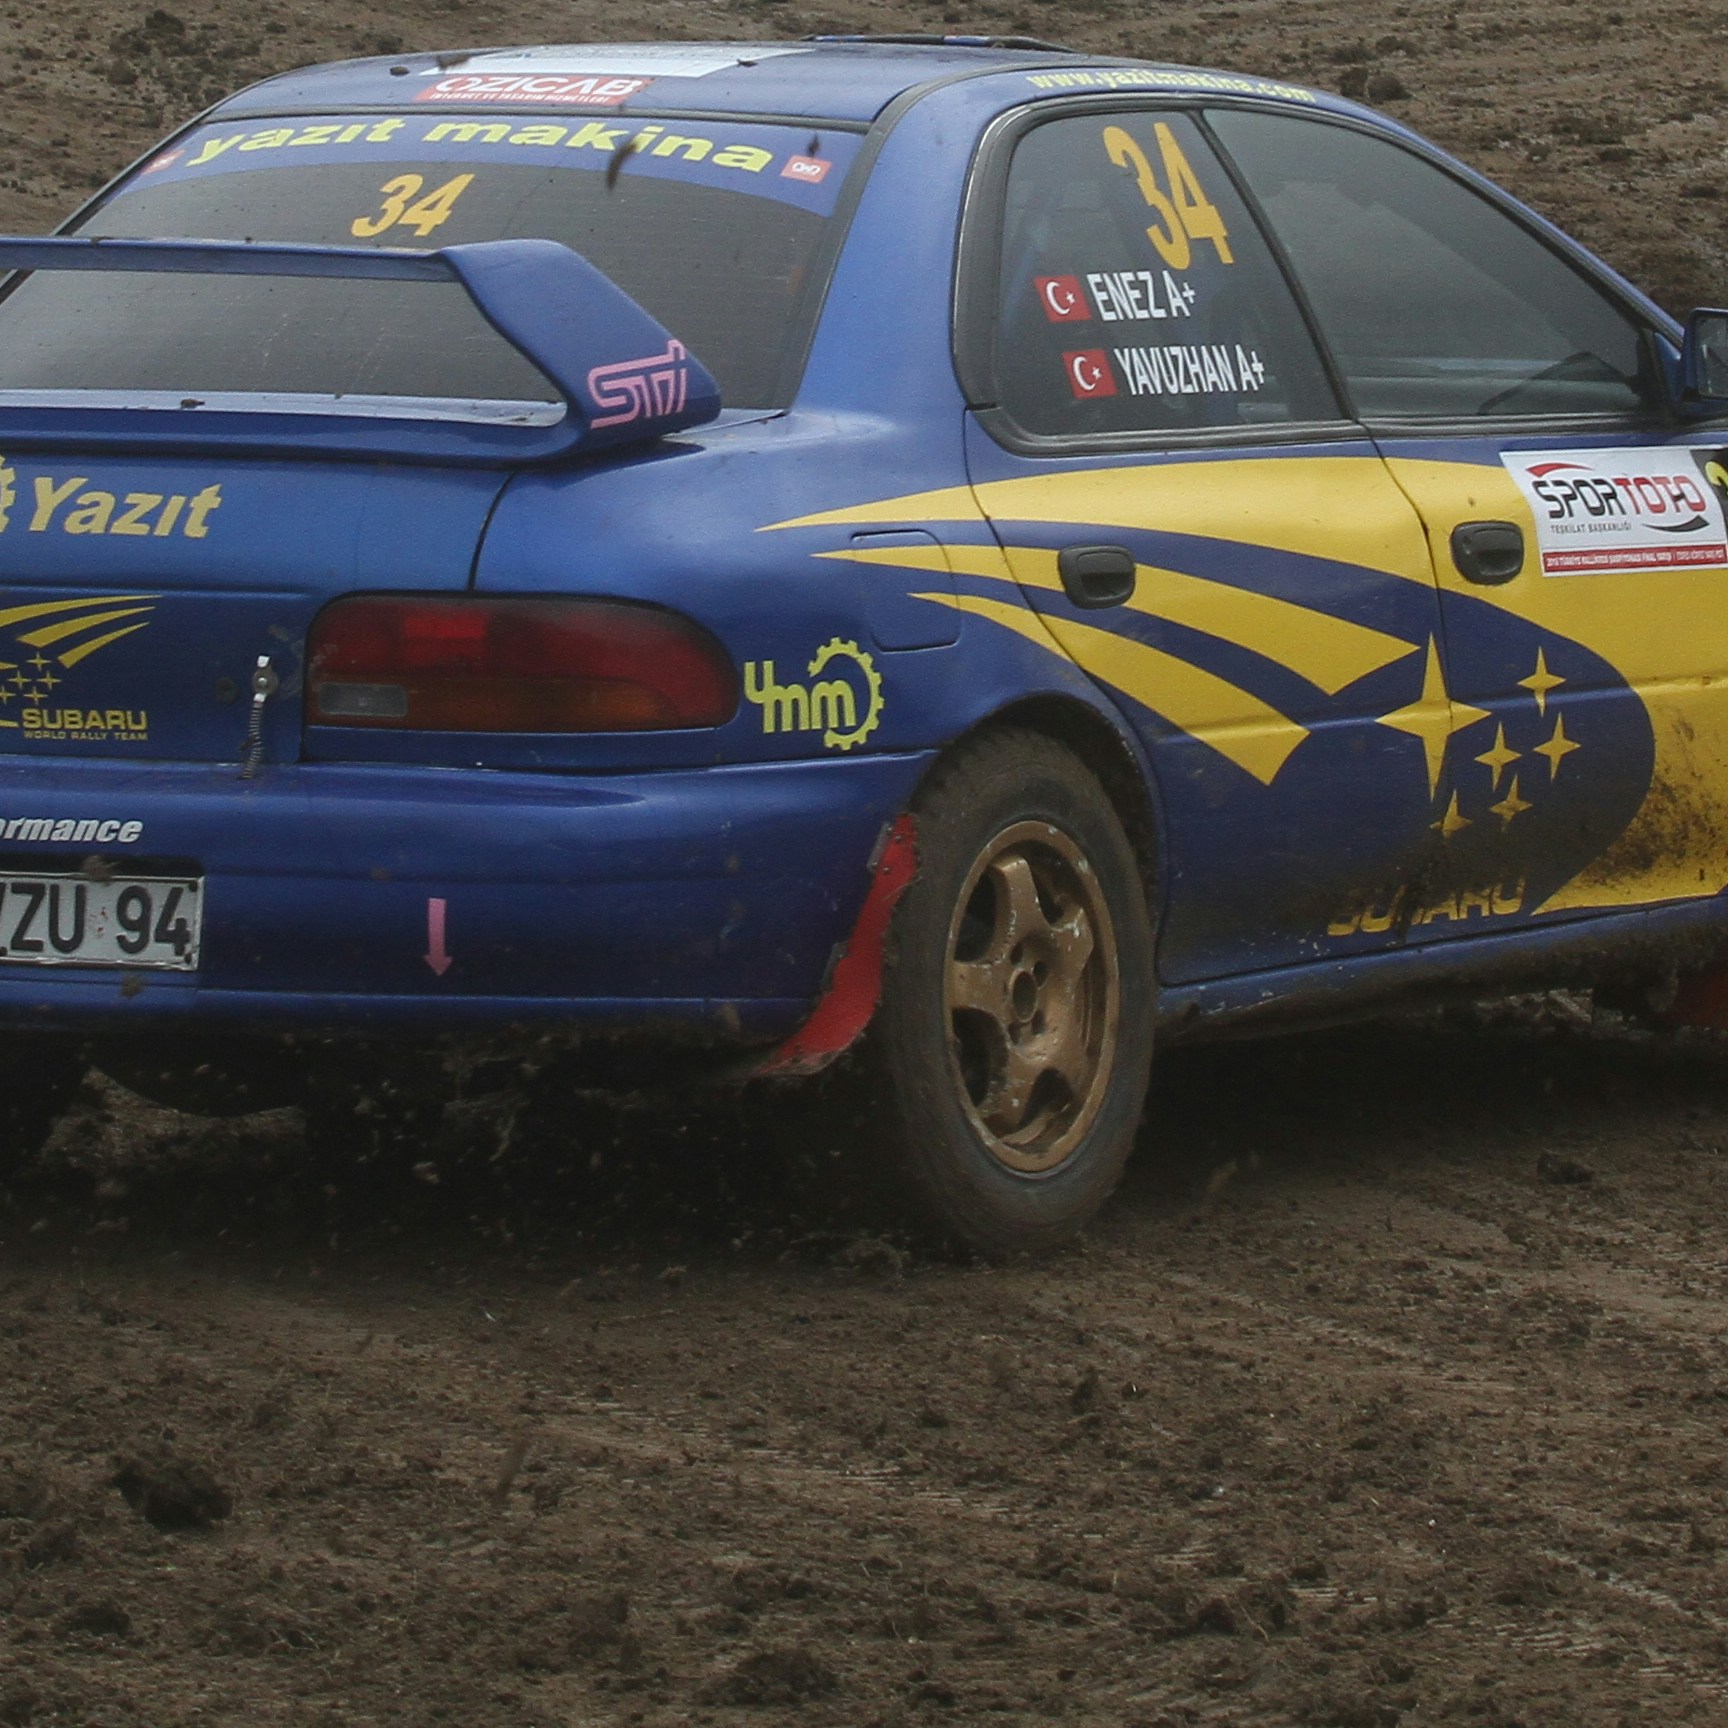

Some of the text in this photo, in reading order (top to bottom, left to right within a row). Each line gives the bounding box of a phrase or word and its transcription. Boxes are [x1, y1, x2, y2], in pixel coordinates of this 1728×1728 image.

[422, 122, 773, 173] makina
[350, 172, 476, 238] 34
[1102, 121, 1235, 271] 34
[1086, 270, 1197, 322] ENEZ A+
[1113, 343, 1265, 396] YAVUZHAN A+
[21, 708, 148, 732] SUBARU
[23, 730, 149, 741] WORLD RALLY TEAM
[115, 884, 191, 957] 94
